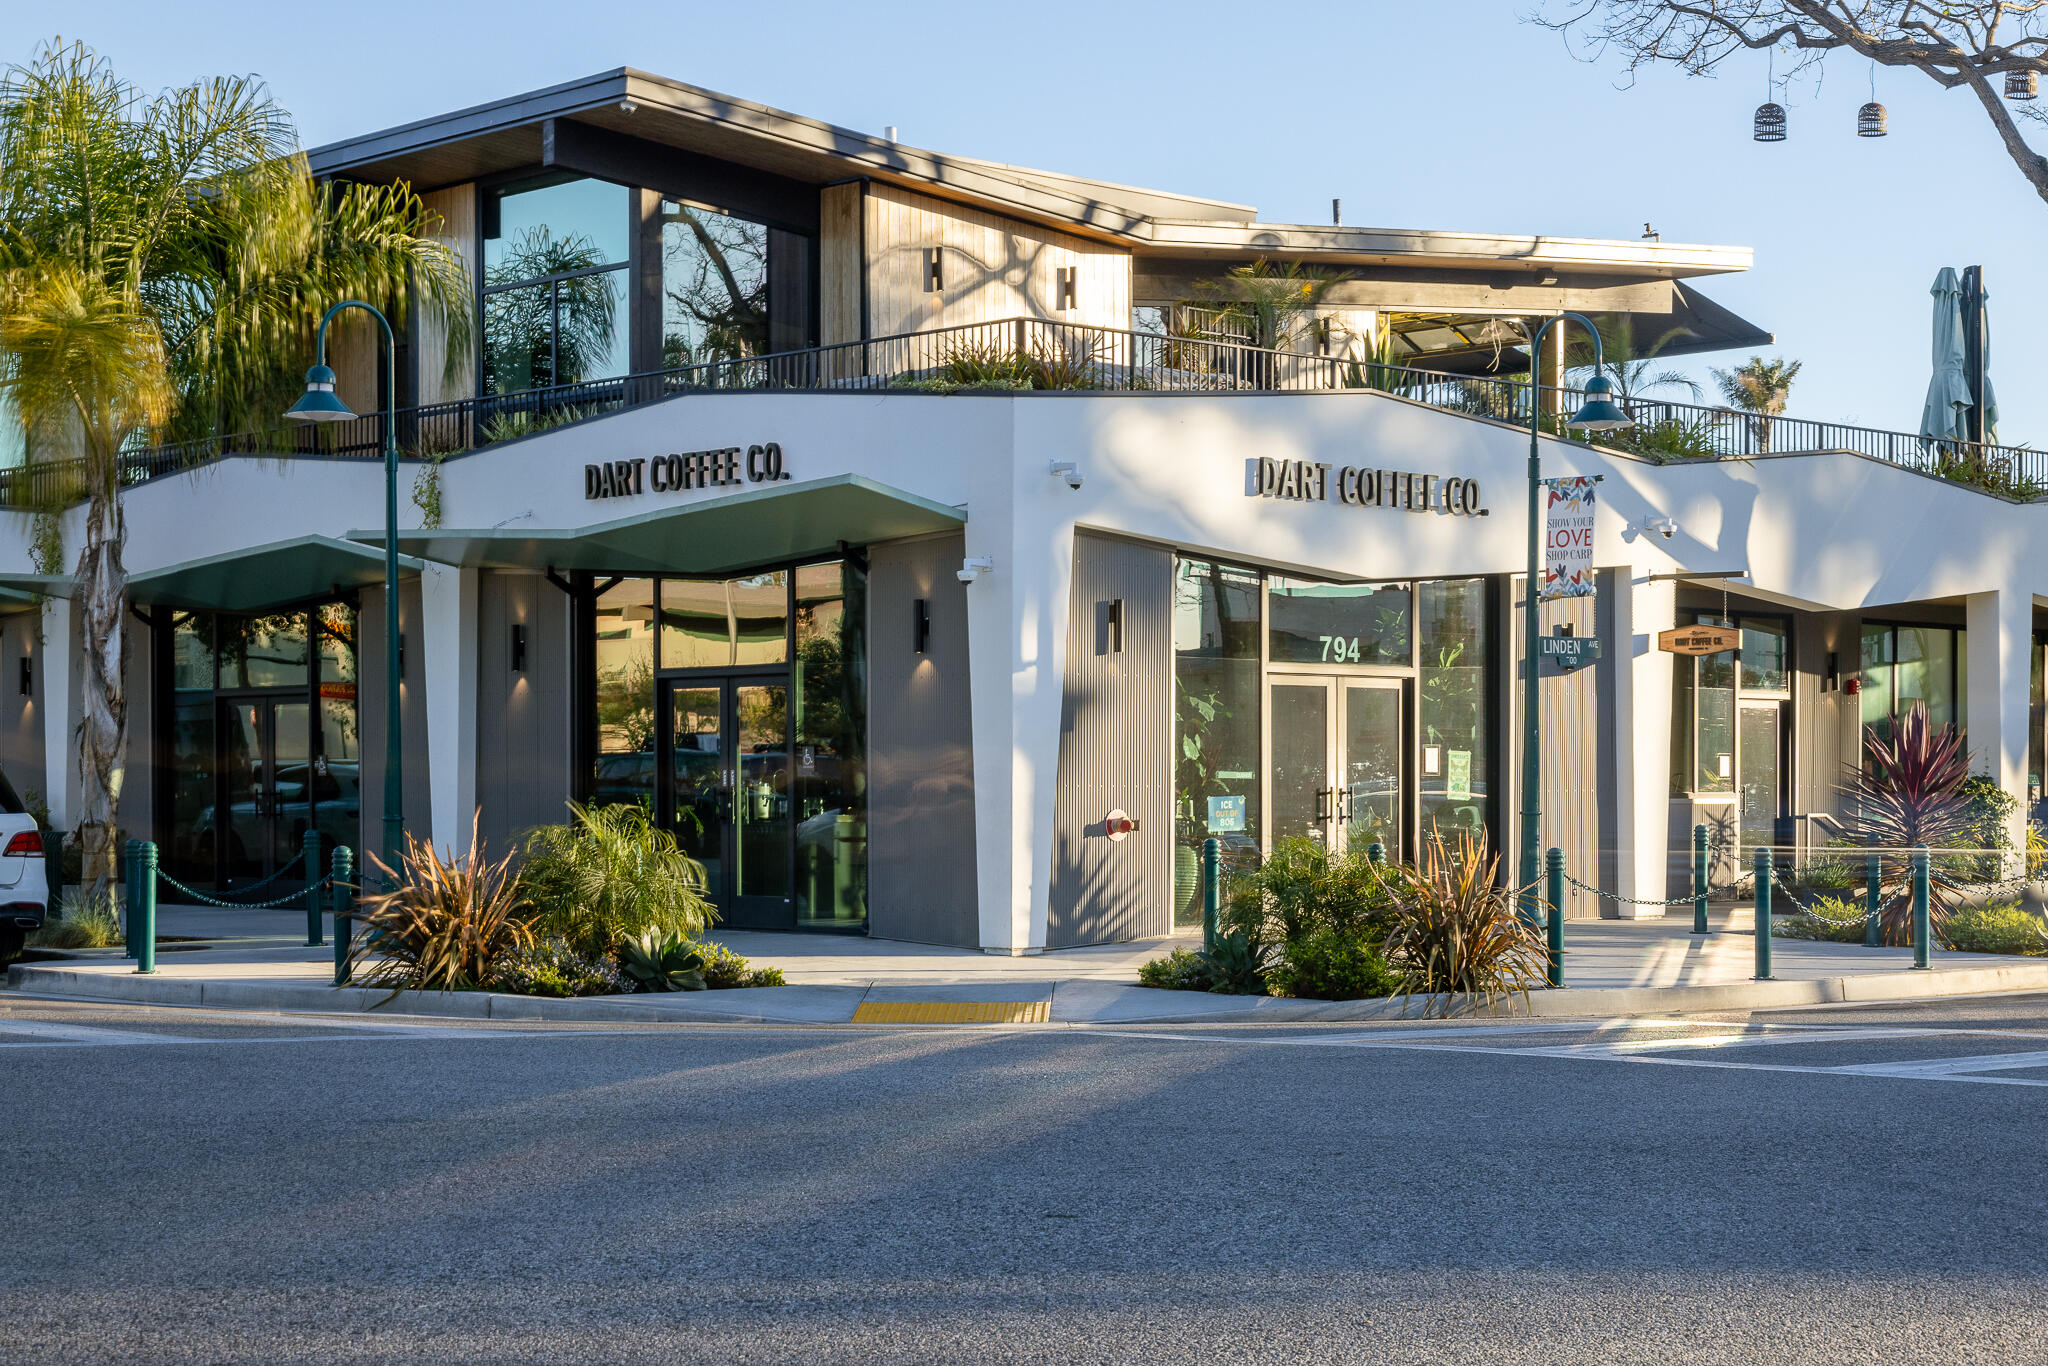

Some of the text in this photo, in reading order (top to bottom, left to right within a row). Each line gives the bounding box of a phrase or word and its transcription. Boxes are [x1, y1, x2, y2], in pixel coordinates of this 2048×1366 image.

[585, 442, 791, 500] DART COFFEE CO.
[1259, 457, 1490, 516] DART COFFEE CO.
[1547, 516, 1594, 528] SHOW YOUR
[1547, 528, 1592, 548] LOVE
[1546, 549, 1593, 561] SHOP CARP
[1319, 635, 1361, 663] 794
[1543, 639, 1599, 655] LINDEN AVE
[1220, 800, 1233, 809] ICE
[1215, 810, 1229, 818] OUT
